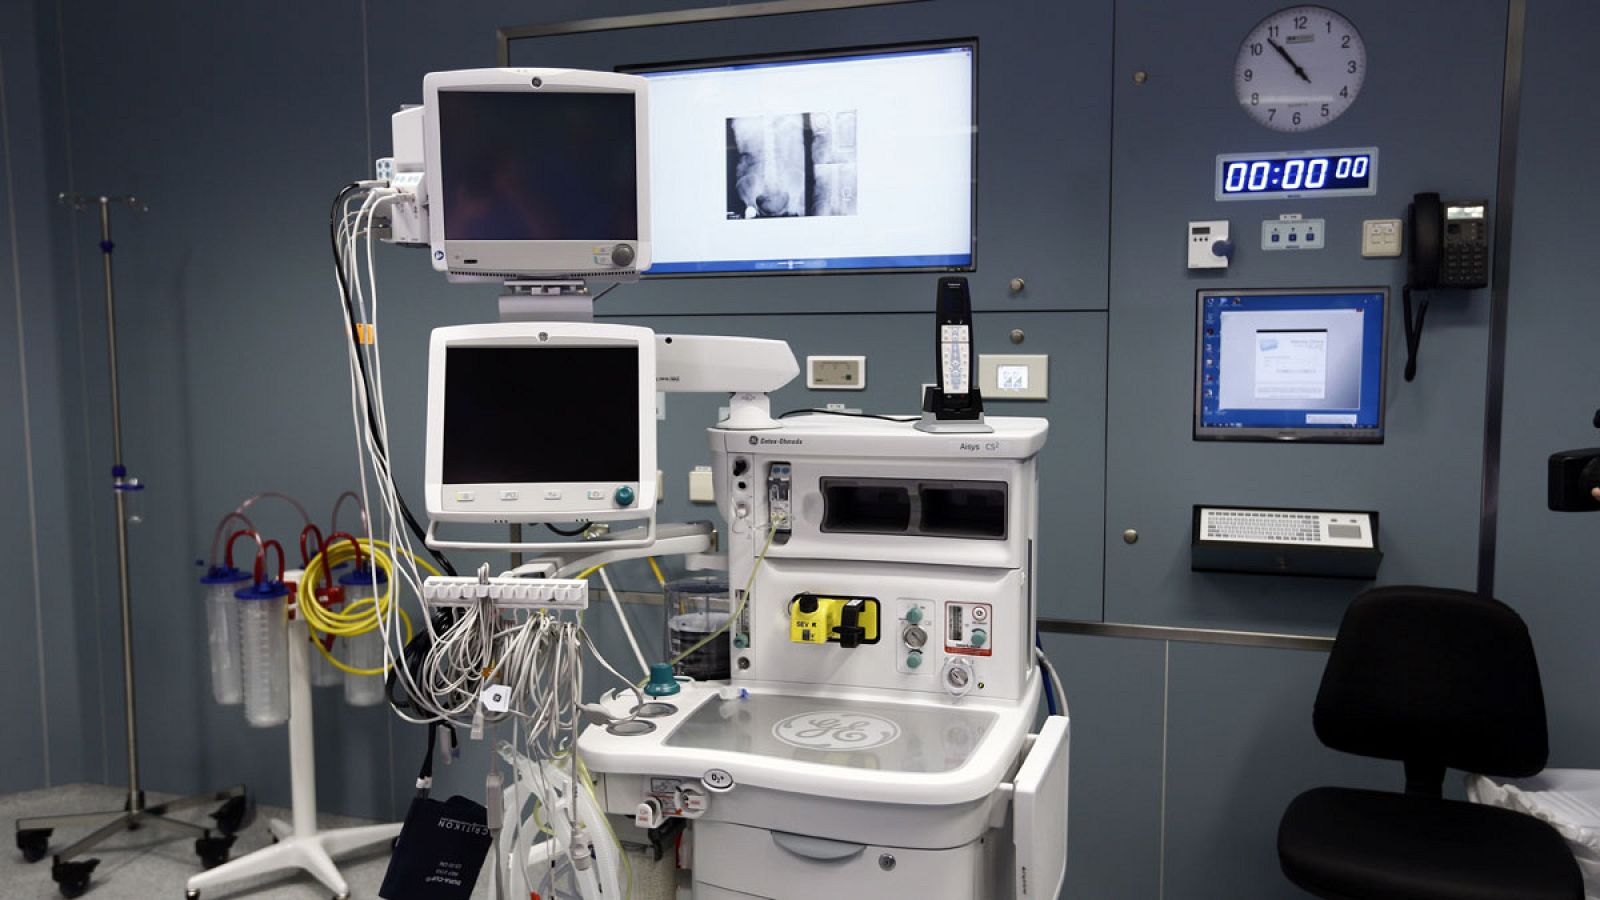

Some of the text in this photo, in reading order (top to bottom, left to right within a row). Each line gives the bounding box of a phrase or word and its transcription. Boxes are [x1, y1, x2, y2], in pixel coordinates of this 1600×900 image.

[1294, 16, 1308, 29] 12
[1326, 21, 1331, 34] 1
[1268, 25, 1279, 38] 11
[1341, 35, 1351, 48] 2
[1250, 43, 1263, 56] 10
[1347, 60, 1357, 74] 3
[1243, 68, 1253, 82] 9
[1339, 85, 1348, 98] 4
[1251, 92, 1259, 106] 8
[1268, 108, 1276, 122] 7
[1320, 103, 1329, 117] 5
[1292, 111, 1301, 125] 6
[1225, 156, 1369, 192] 00:00 00
[960, 442, 981, 451] Aisys
[438, 820, 489, 835] CRITIKON
